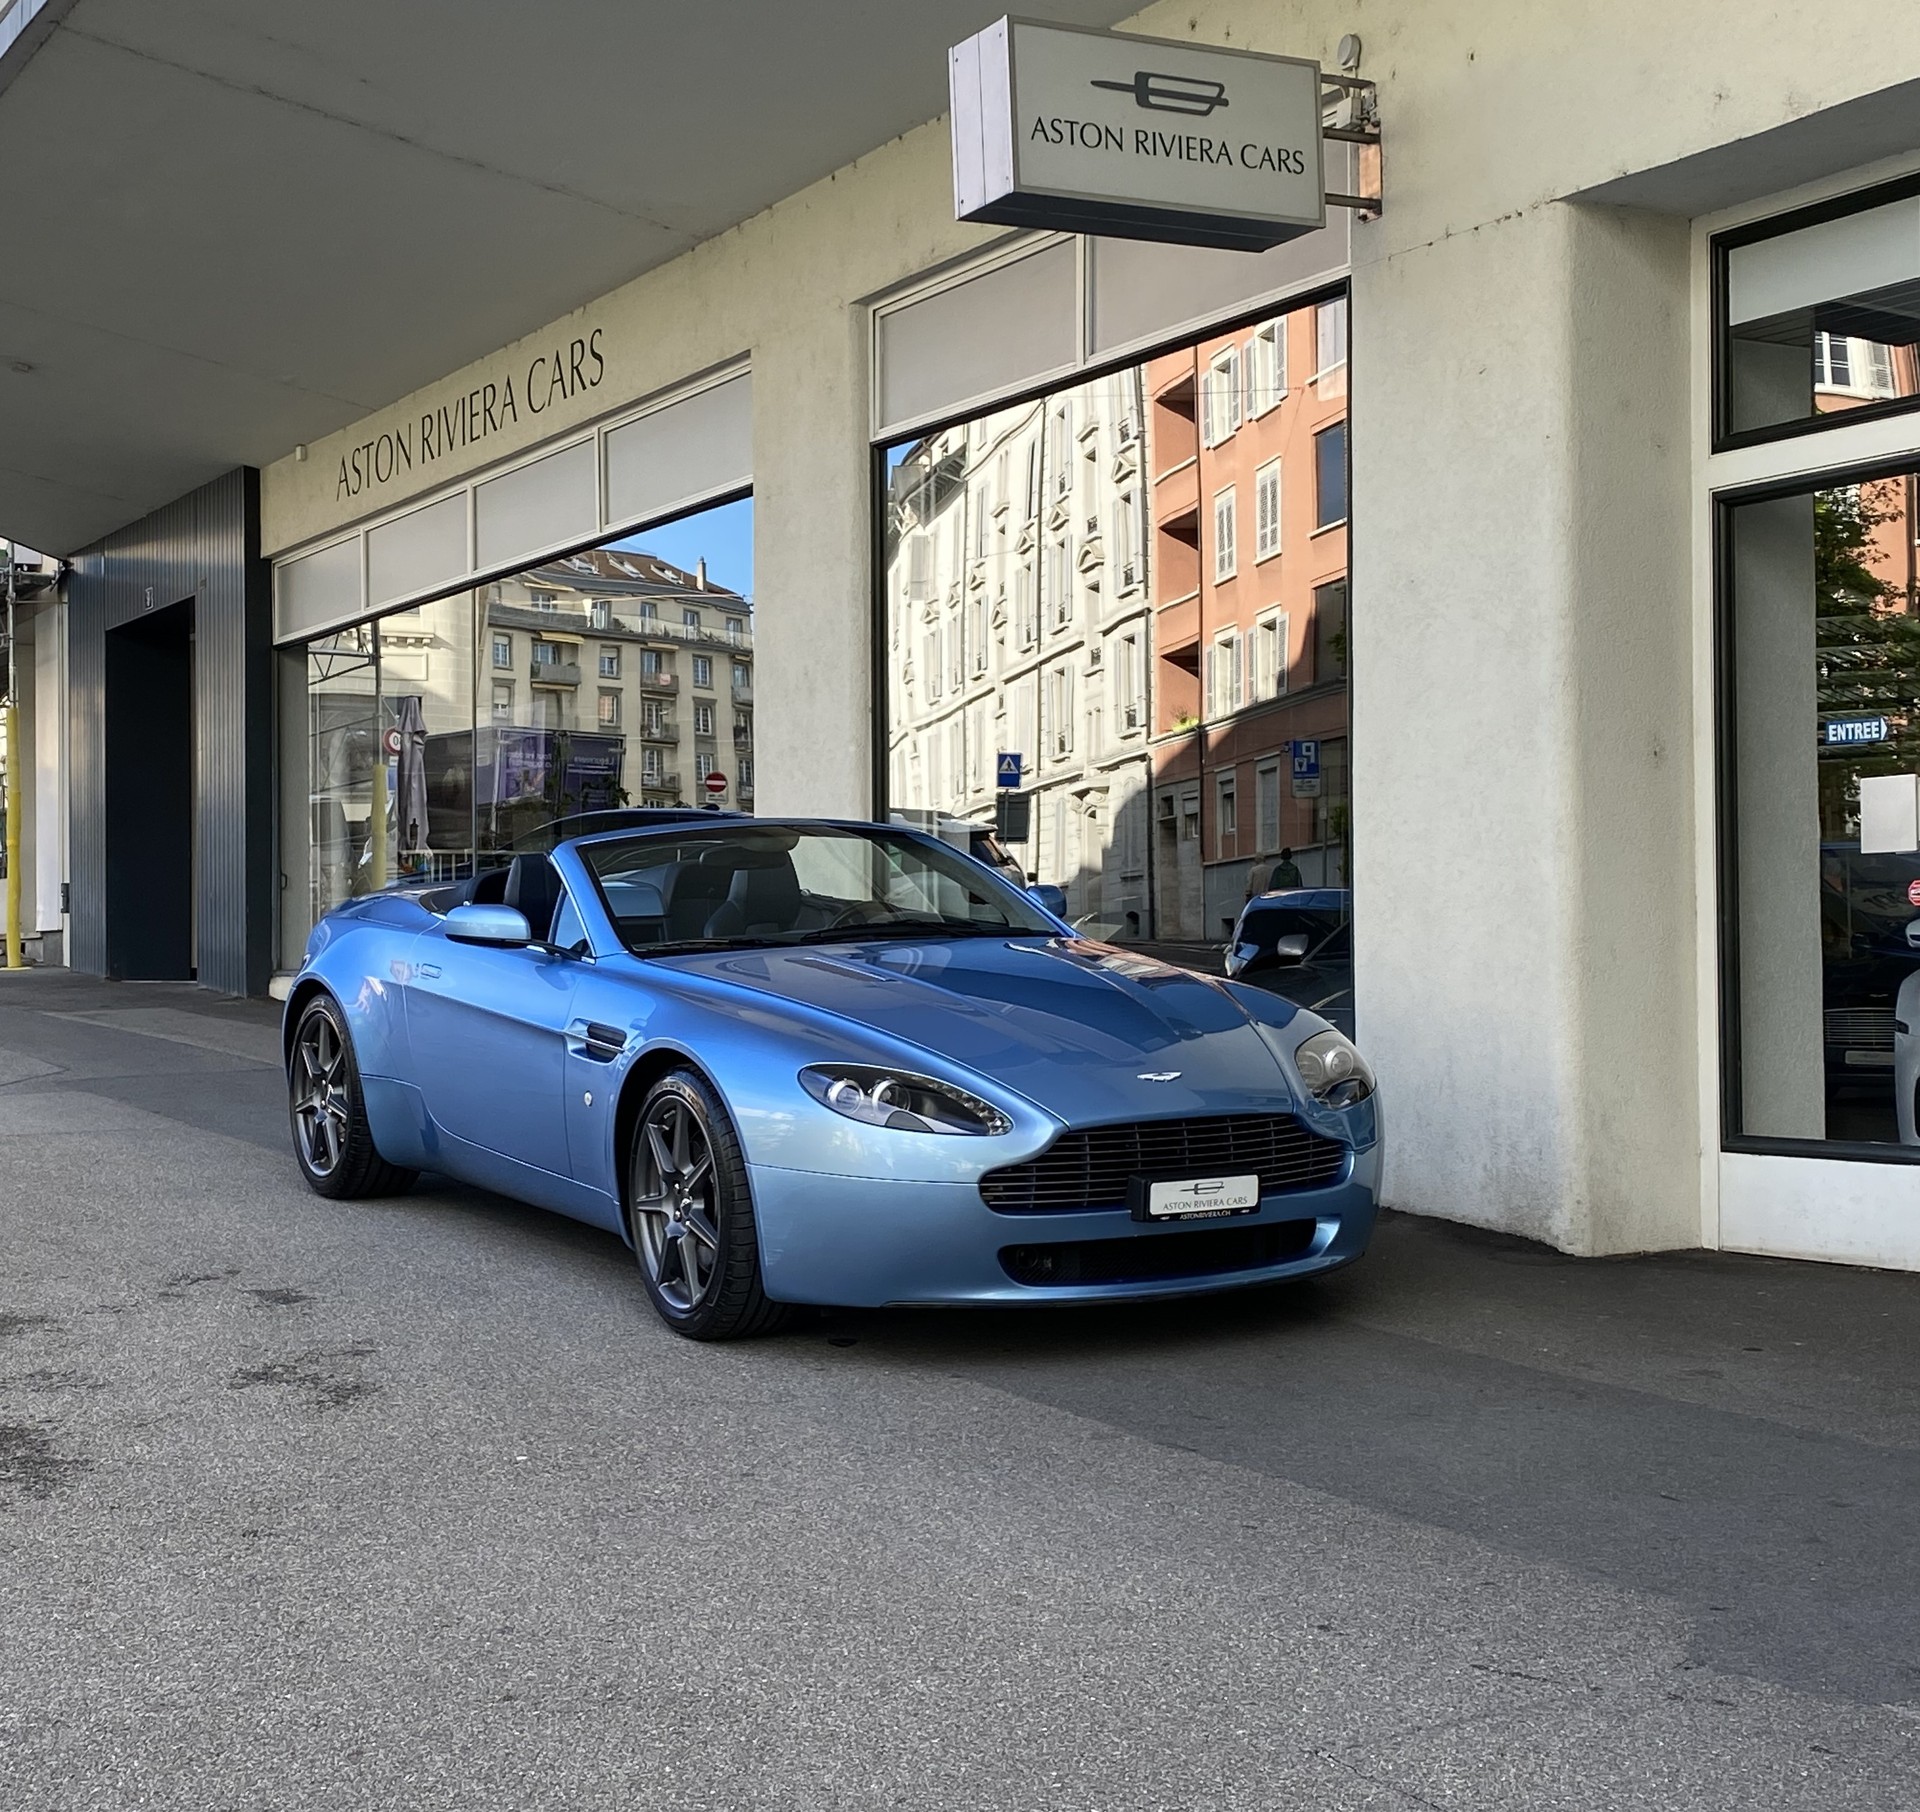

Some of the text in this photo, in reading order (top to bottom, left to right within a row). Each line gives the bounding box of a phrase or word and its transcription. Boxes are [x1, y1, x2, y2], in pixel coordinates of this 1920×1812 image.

[1031, 116, 1306, 175] ASTON RIVIERA CARS
[336, 328, 605, 502] ASTON RIVIERA CARS
[1828, 721, 1880, 742] ENTREE
[1163, 1196, 1248, 1211] ASTON RIVIERA CARS
